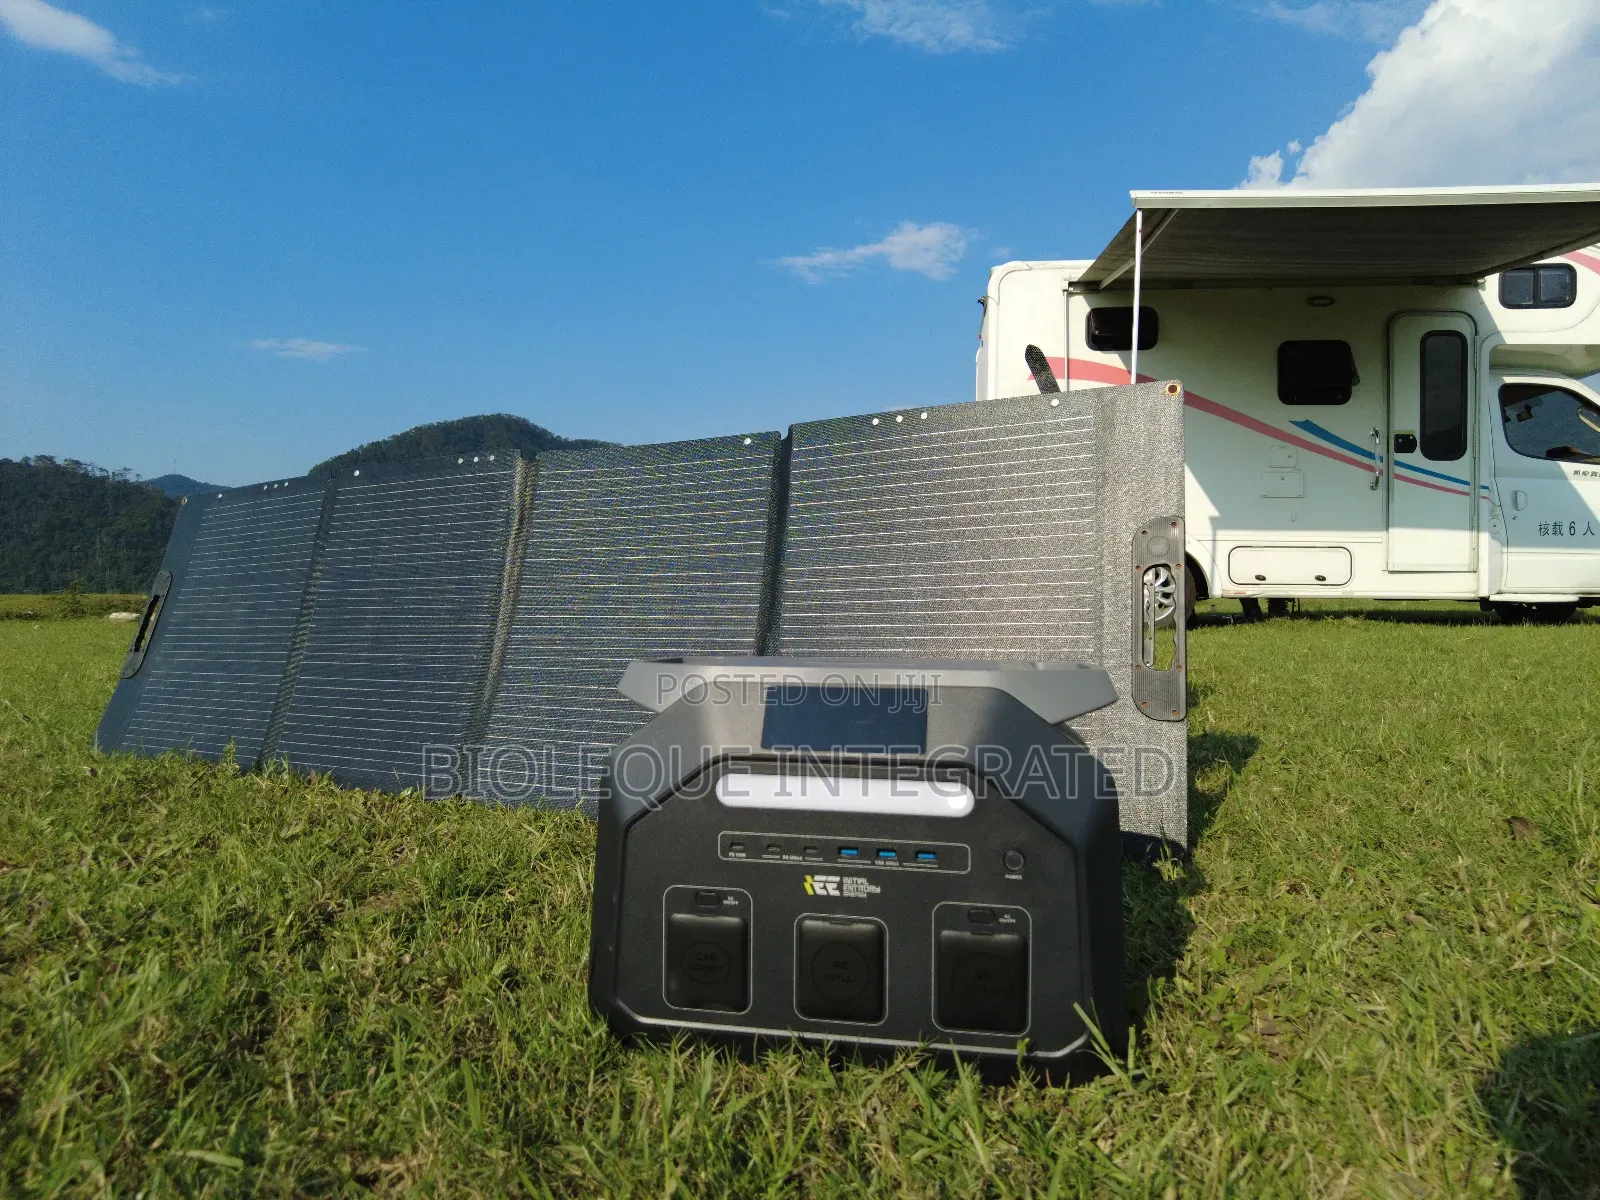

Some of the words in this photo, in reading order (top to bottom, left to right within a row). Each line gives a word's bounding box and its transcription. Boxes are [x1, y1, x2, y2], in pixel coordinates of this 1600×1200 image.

[1538, 521, 1564, 537] 核载
[1569, 521, 1576, 536] 6
[1582, 521, 1595, 536] 人
